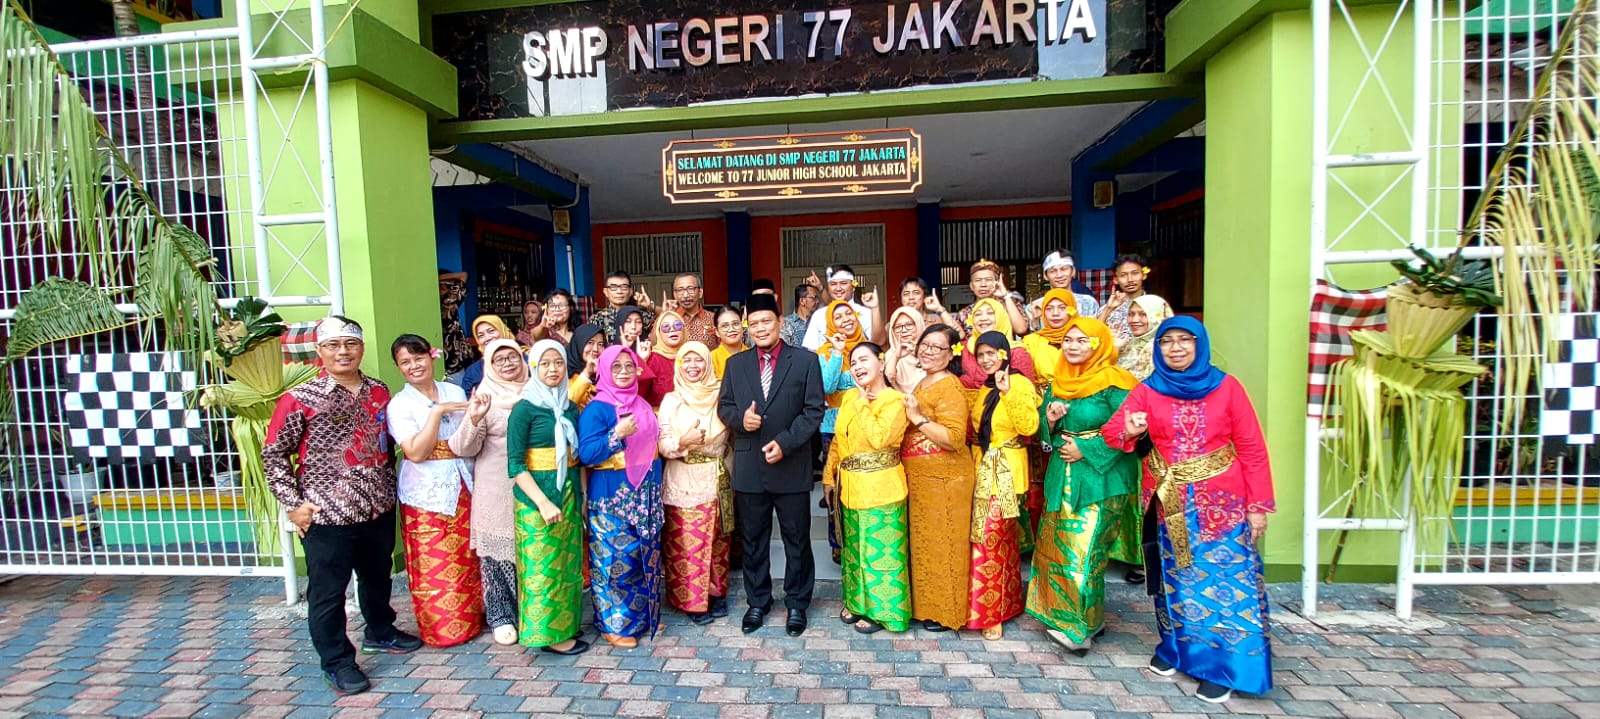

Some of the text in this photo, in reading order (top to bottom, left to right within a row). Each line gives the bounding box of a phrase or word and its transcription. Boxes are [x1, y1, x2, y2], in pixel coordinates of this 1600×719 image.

[522, 0, 1096, 78] SMP NEGERI 77 JAKARTA
[678, 146, 906, 170] SELAMAT DATANG DI SMP NEGERI 77 JAKARTA
[678, 162, 906, 185] WELCOME TO 77 JUNIOR HIGH SCHOOL JAKARTA
